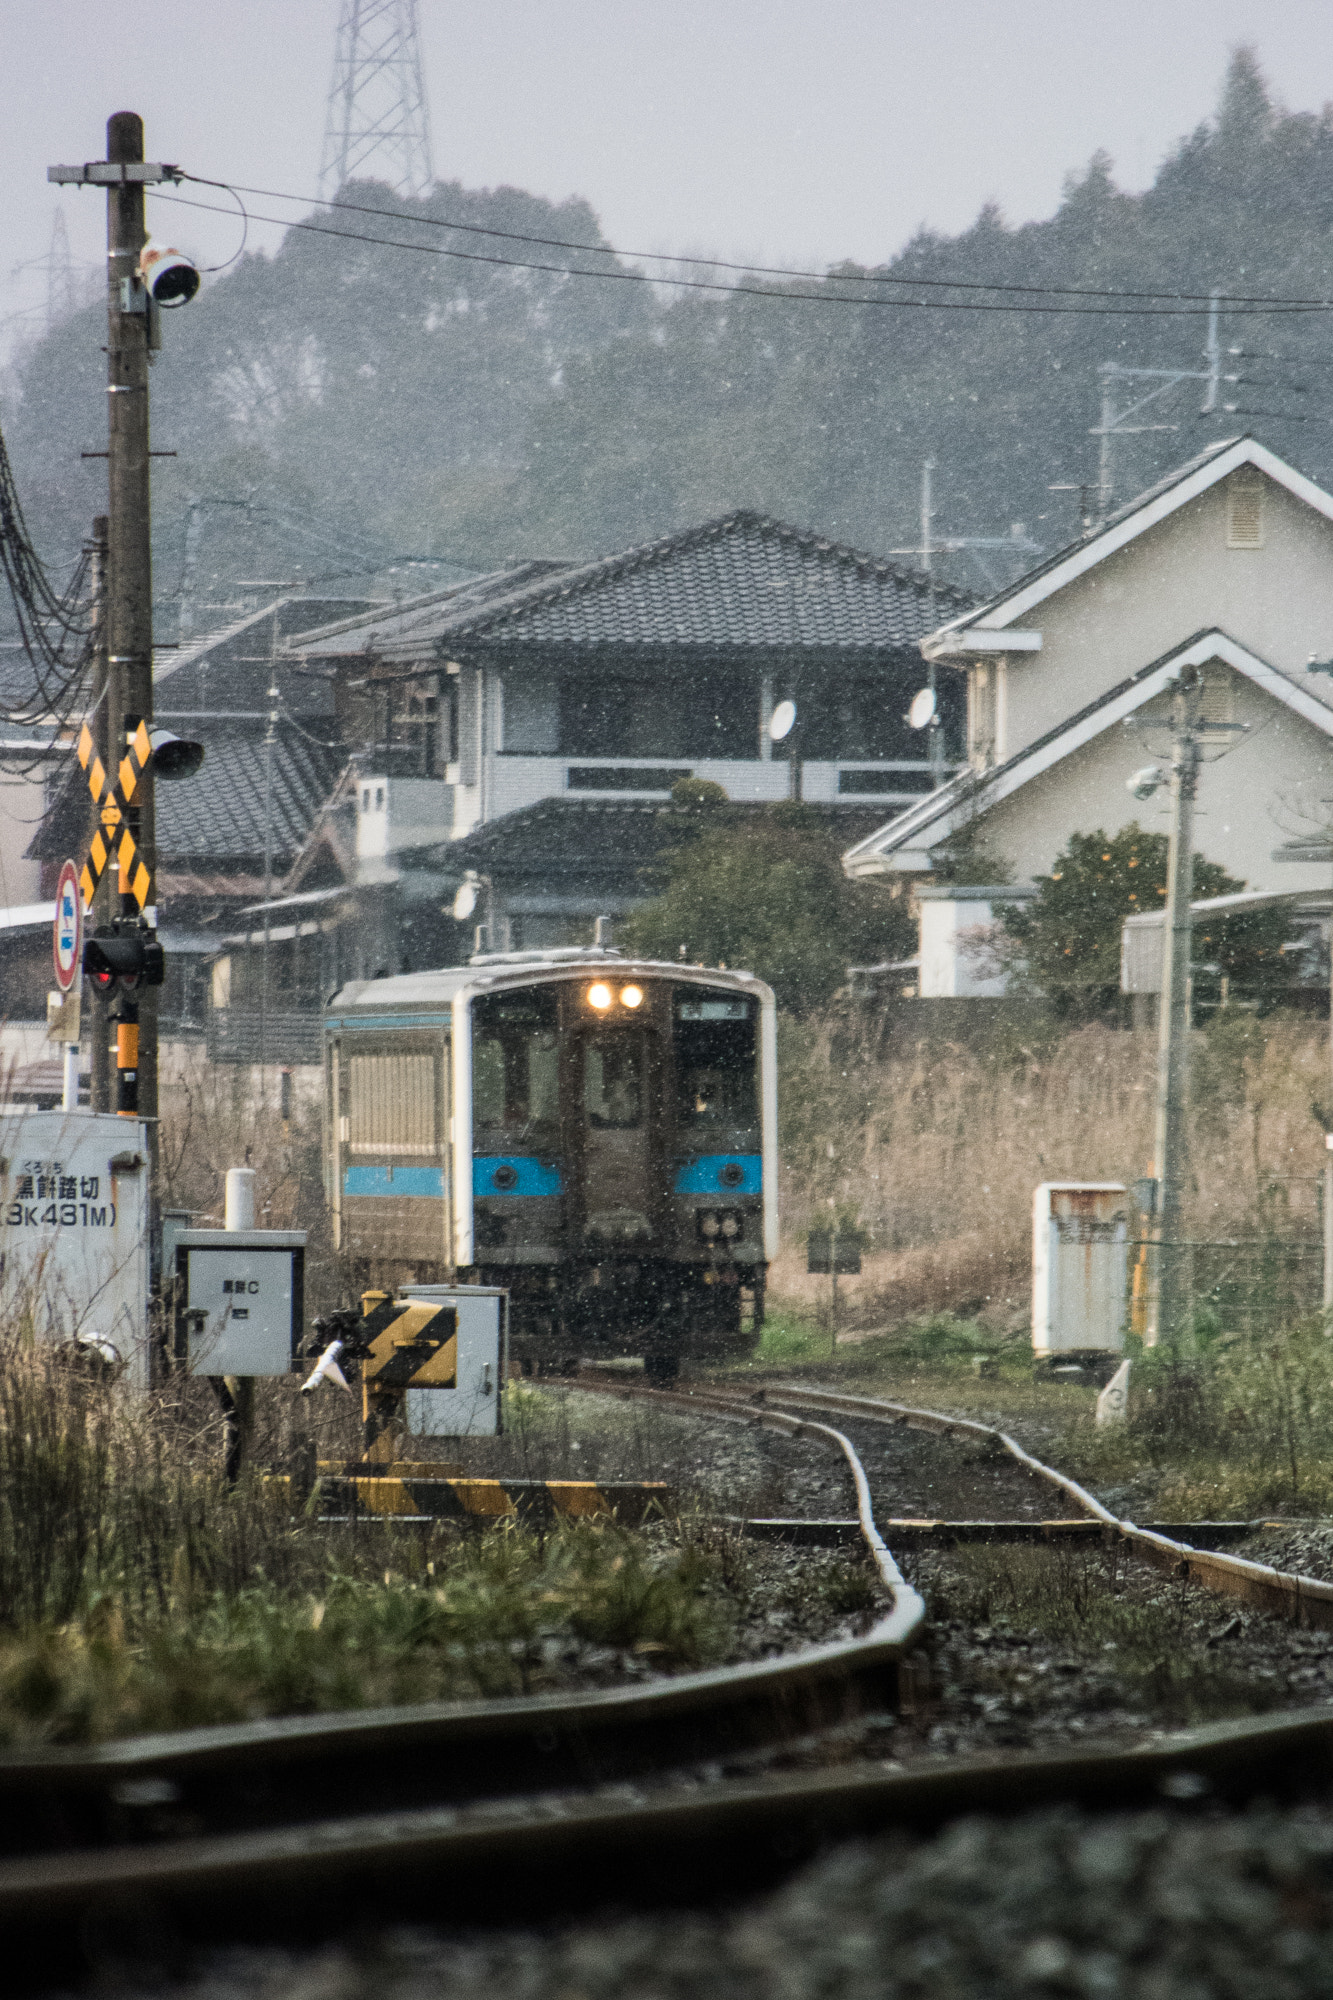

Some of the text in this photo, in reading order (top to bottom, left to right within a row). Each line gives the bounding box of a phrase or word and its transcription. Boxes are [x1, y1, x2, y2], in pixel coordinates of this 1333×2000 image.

[24, 1161, 62, 1174] くろち
[0, 1203, 116, 1227] 3K431M)
